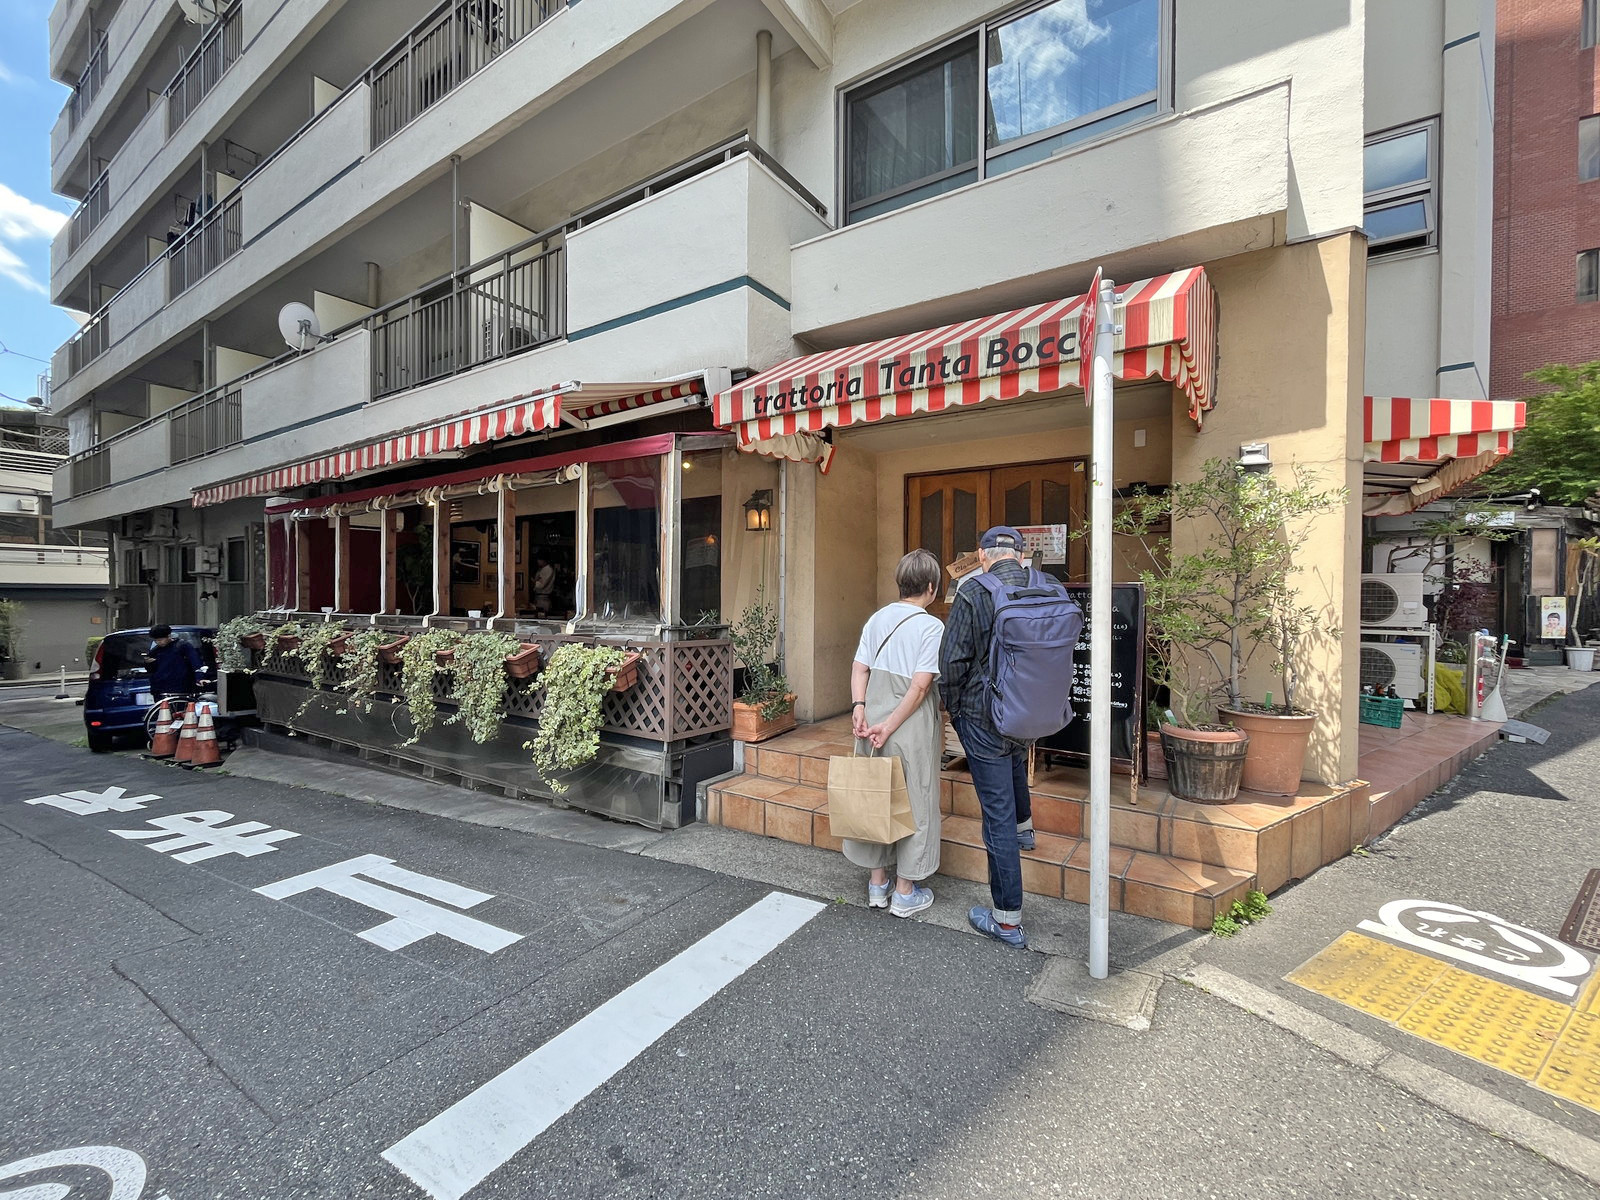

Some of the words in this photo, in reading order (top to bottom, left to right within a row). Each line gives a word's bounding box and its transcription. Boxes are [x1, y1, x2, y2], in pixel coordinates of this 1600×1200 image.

[753, 374, 862, 414] trattoria
[880, 354, 972, 390] Tanta
[986, 332, 1081, 369] Bocc
[24, 785, 525, 954] 止まれ
